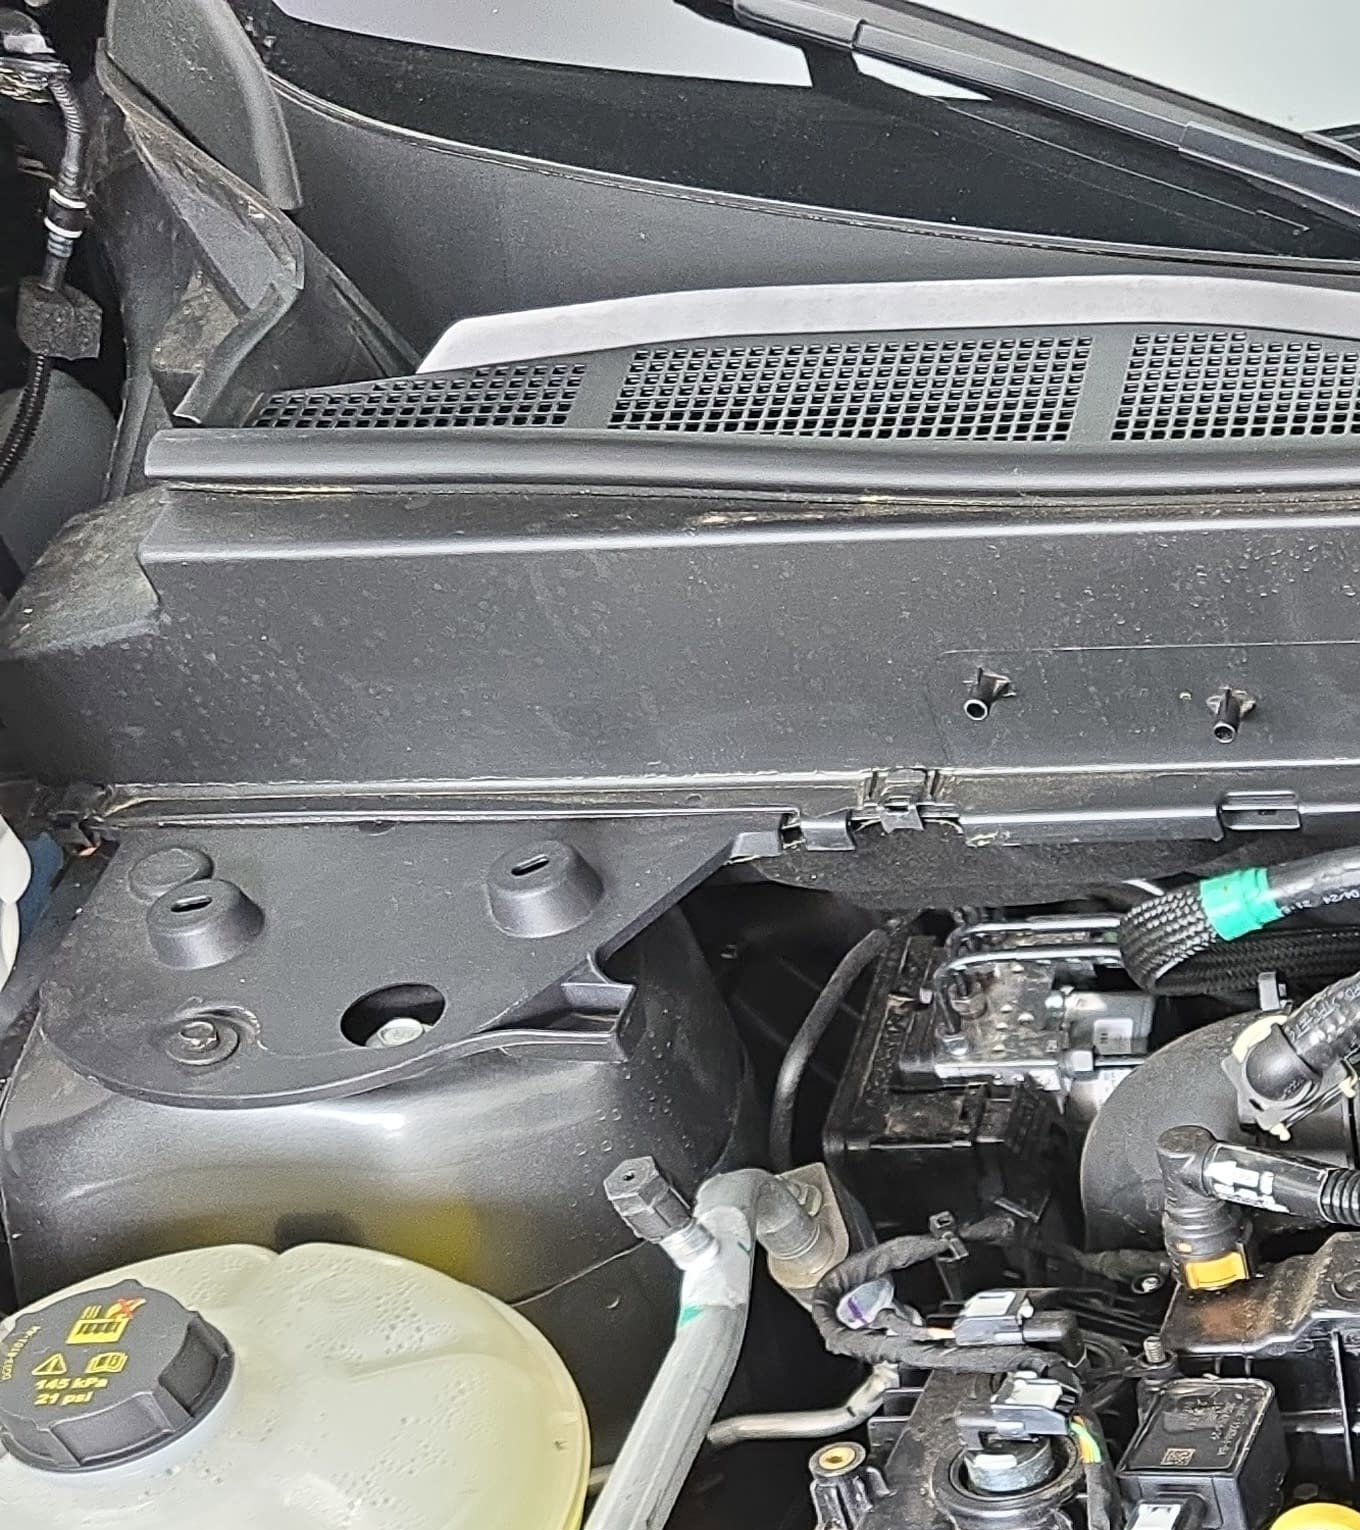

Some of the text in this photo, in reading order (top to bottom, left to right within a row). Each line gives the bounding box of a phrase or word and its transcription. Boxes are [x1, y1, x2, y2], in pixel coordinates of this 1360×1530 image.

[35, 1377, 108, 1390] 145 kPa
[34, 1391, 94, 1406] 21 psi
